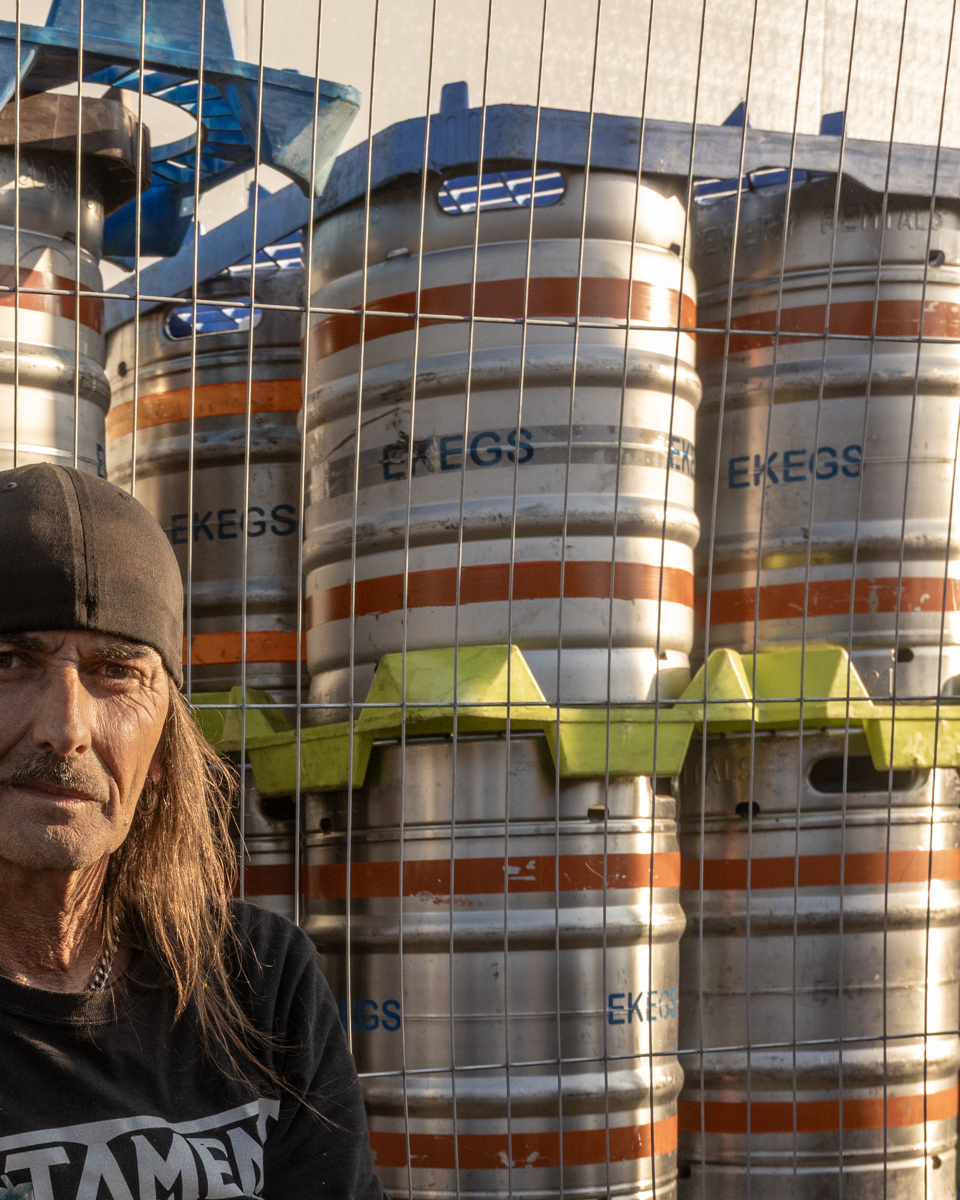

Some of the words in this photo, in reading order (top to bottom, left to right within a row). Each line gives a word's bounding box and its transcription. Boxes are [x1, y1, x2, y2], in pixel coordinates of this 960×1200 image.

[382, 428, 534, 480] EKEGS
[728, 444, 865, 489] EKEGS
[171, 504, 297, 544] EKEGS
